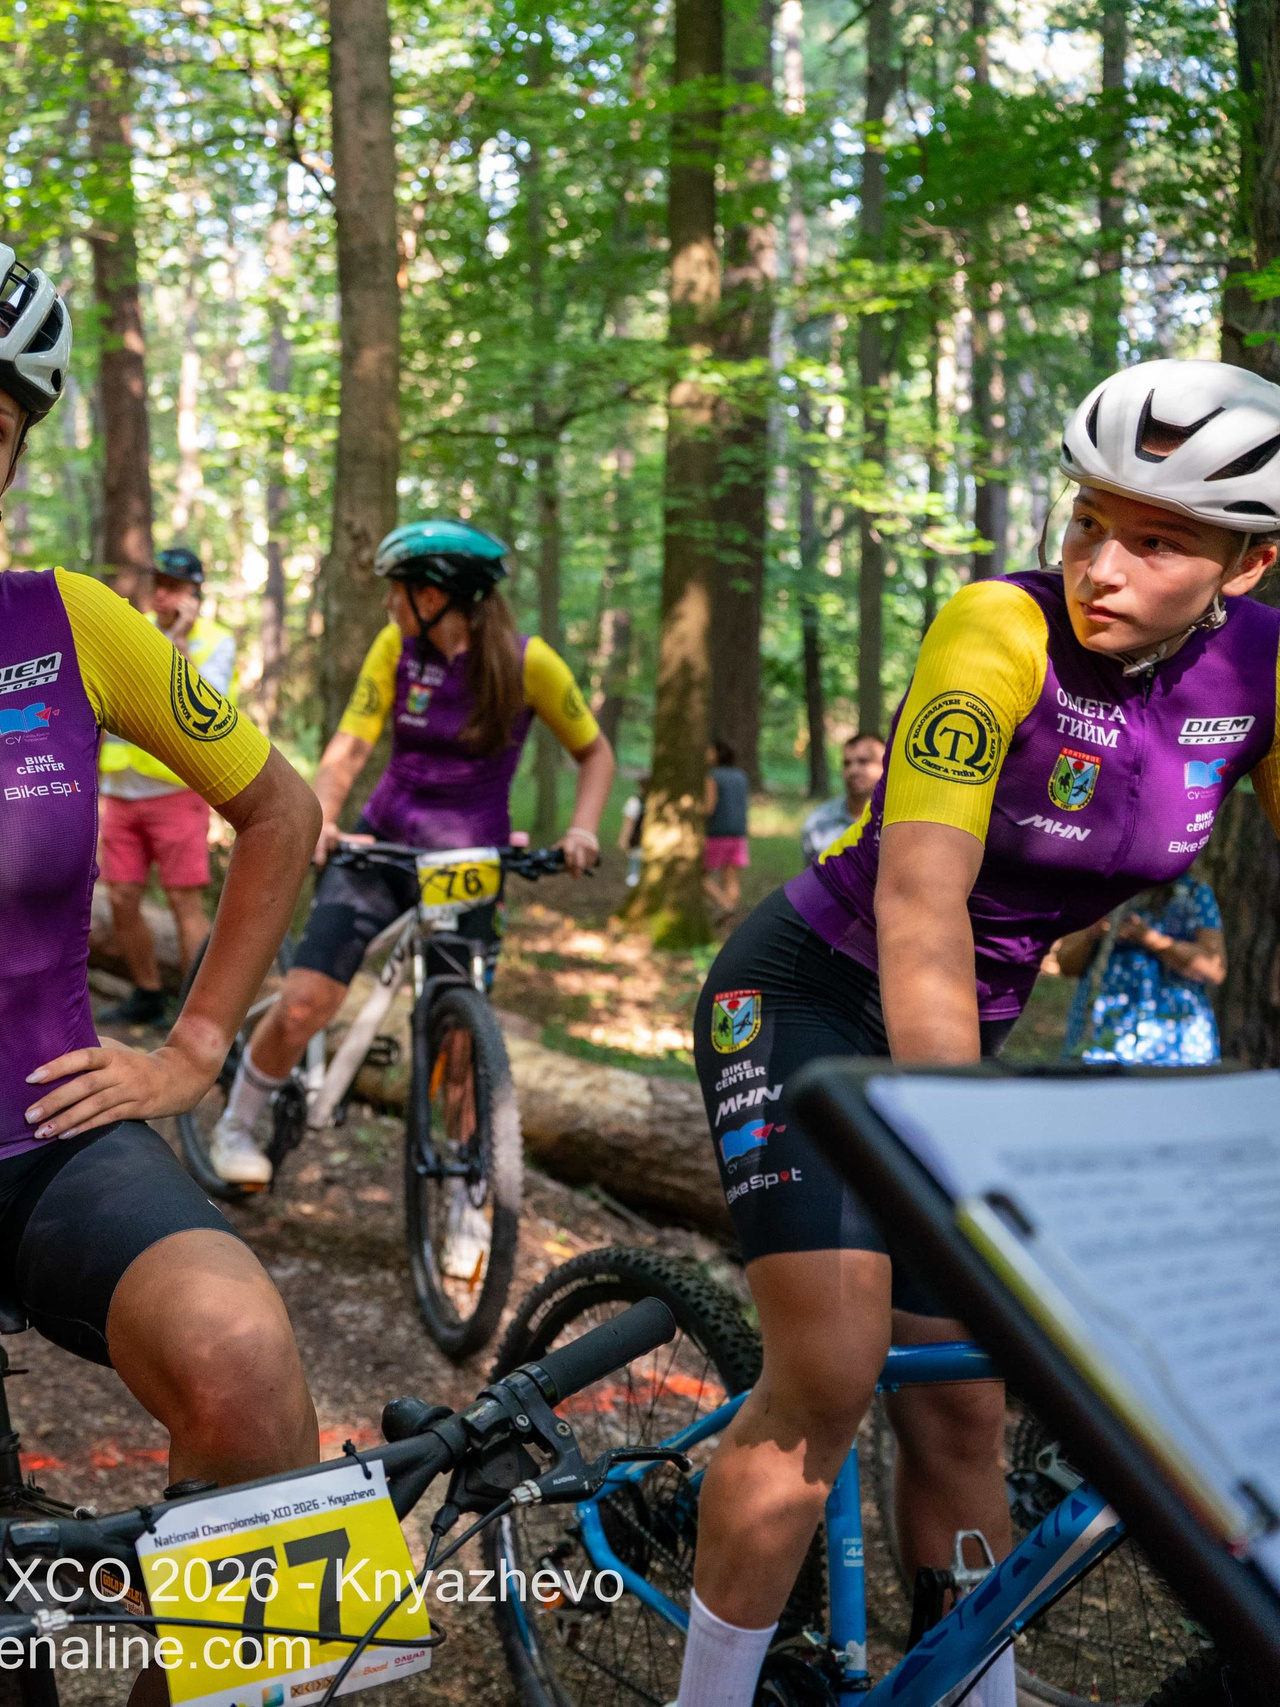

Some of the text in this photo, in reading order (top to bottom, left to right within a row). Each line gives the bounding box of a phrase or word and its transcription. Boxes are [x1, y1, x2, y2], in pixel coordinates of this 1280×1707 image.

[1056, 687, 1127, 725] ОМЕГА
[1056, 712, 1121, 748] ТИЙМ
[1185, 717, 1250, 733] DIEM
[1183, 735, 1241, 744] SPORT
[16, 762, 66, 775] CENTER
[25, 754, 56, 766] BIKE
[1015, 814, 1092, 841] MHN
[435, 867, 483, 898] 76
[715, 1066, 767, 1092] CENTER
[721, 1060, 753, 1078] BIKE
[715, 1084, 783, 1127] MHN
[153, 1528, 200, 1549] National
[201, 1513, 271, 1537] Championship
[271, 1506, 293, 1521] XCO
[293, 1499, 320, 1516] 2026
[327, 1488, 376, 1507] Knyazhevo
[207, 1527, 351, 1662] 77
